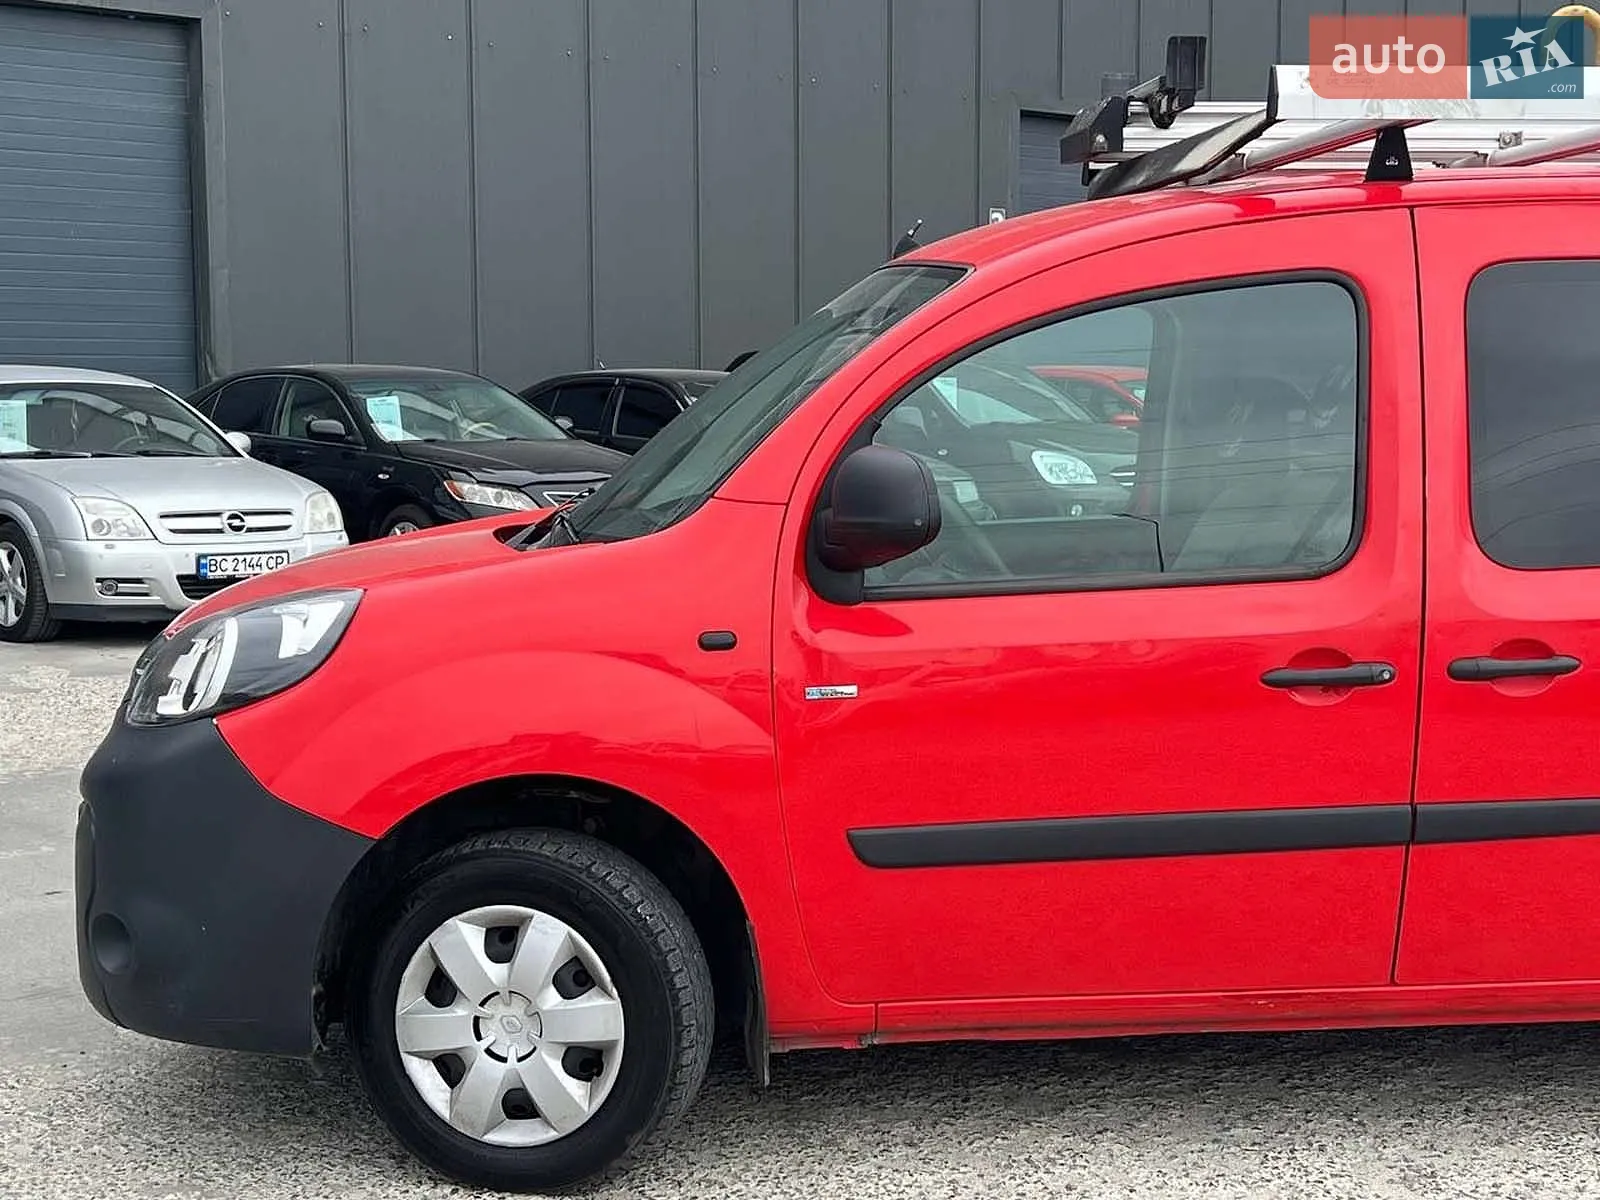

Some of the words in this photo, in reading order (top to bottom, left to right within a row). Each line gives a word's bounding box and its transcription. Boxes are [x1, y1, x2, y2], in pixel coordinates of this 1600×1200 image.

[208, 558, 228, 573] BC
[231, 556, 263, 572] 2144
[265, 555, 285, 570] CP
